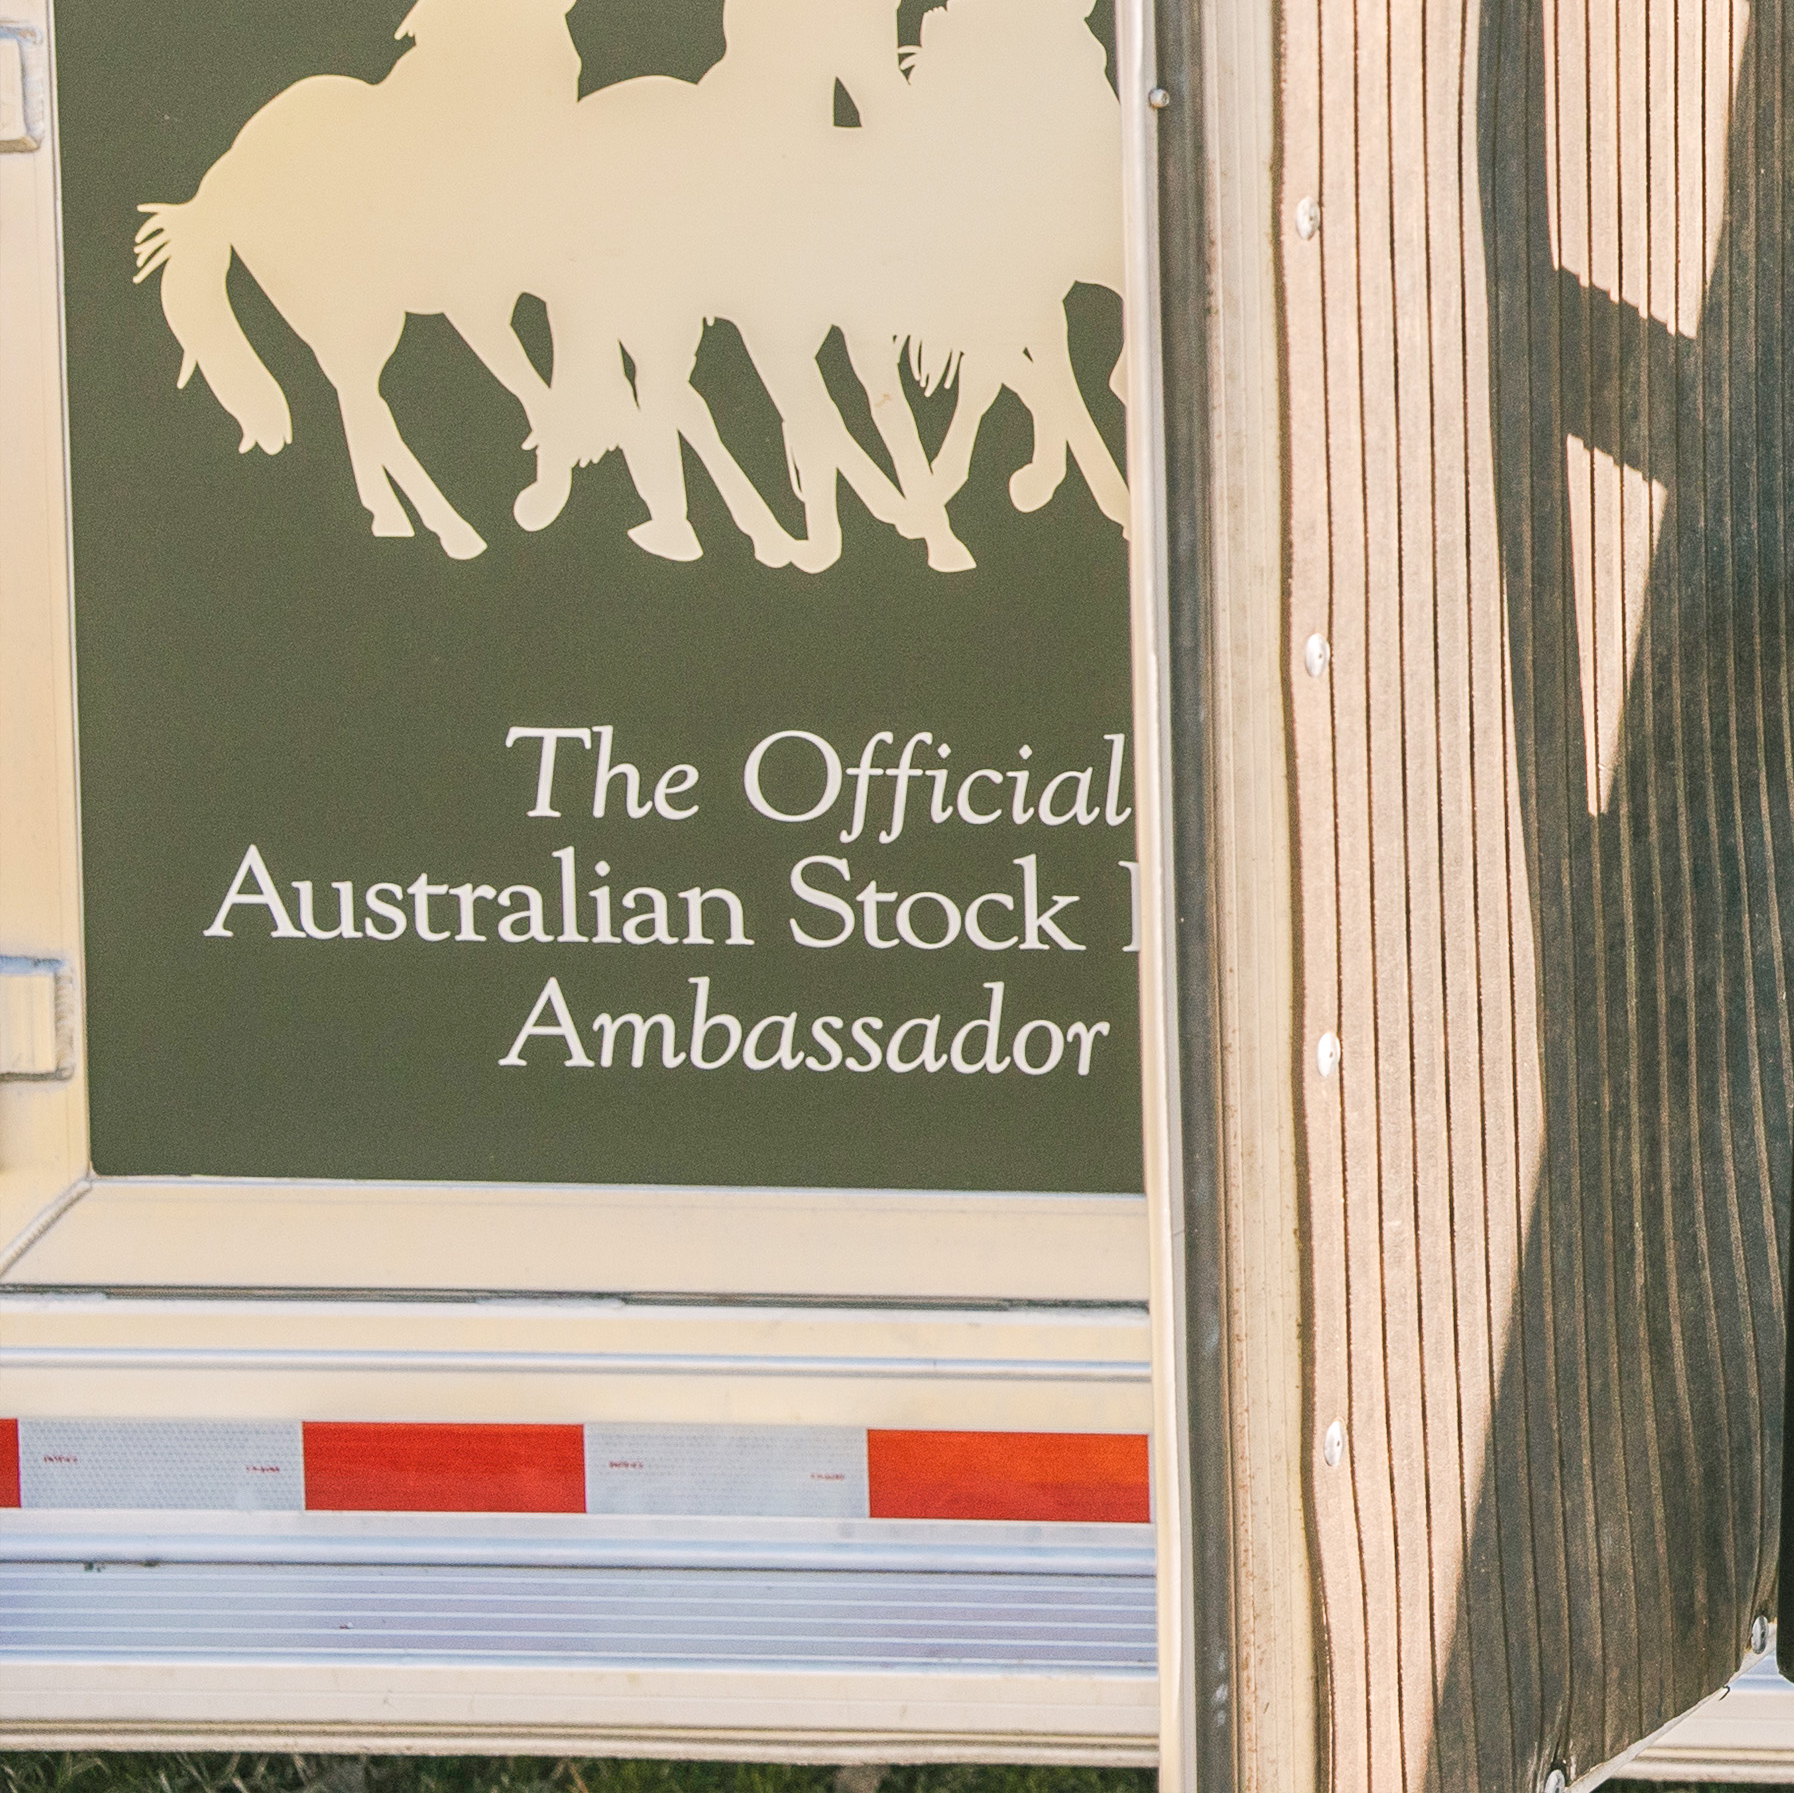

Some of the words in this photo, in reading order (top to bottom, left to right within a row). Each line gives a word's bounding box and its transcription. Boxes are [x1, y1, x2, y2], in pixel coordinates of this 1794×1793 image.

[505, 724, 699, 820] The
[743, 729, 1133, 844] Official
[202, 844, 755, 946] Australian
[788, 853, 1087, 951] Stock
[497, 976, 1111, 1076] Ambassador
